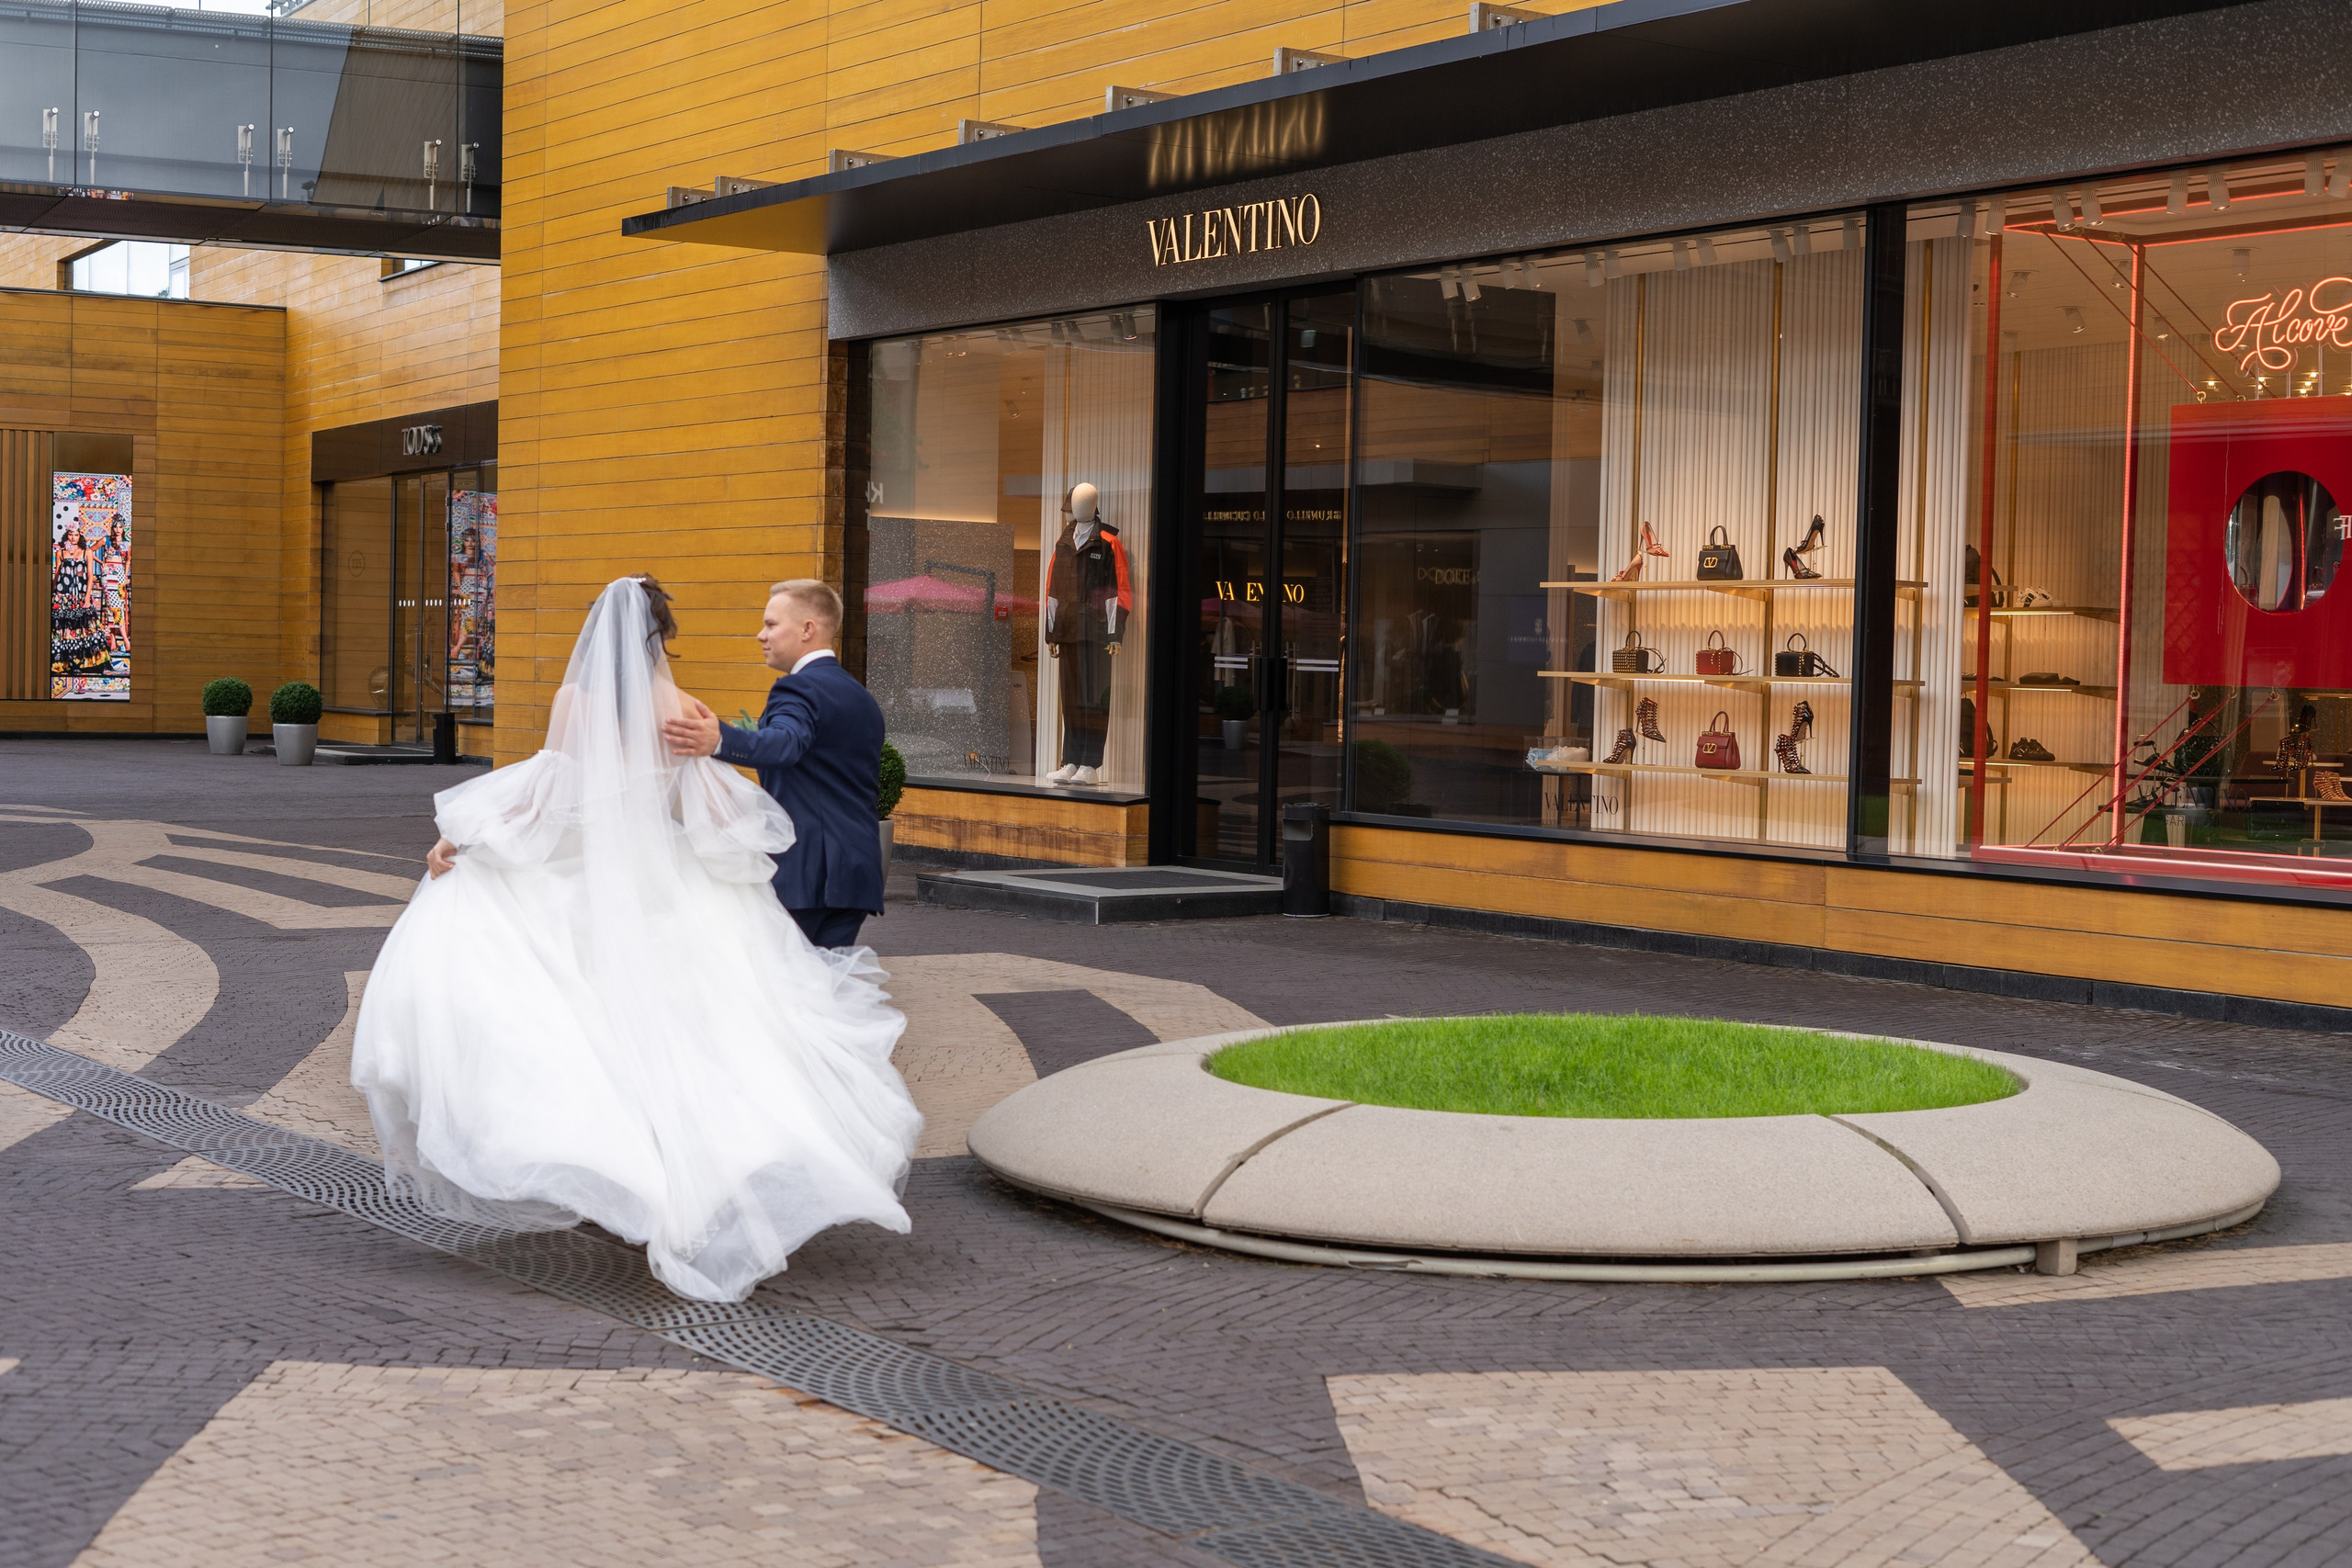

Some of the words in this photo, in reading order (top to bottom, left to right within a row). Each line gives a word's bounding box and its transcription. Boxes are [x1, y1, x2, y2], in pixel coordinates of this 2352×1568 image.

[1146, 193, 1321, 267] VALENTINO
[1216, 581, 1305, 604] VAENNO
[1544, 792, 1619, 815] VALENTINO
